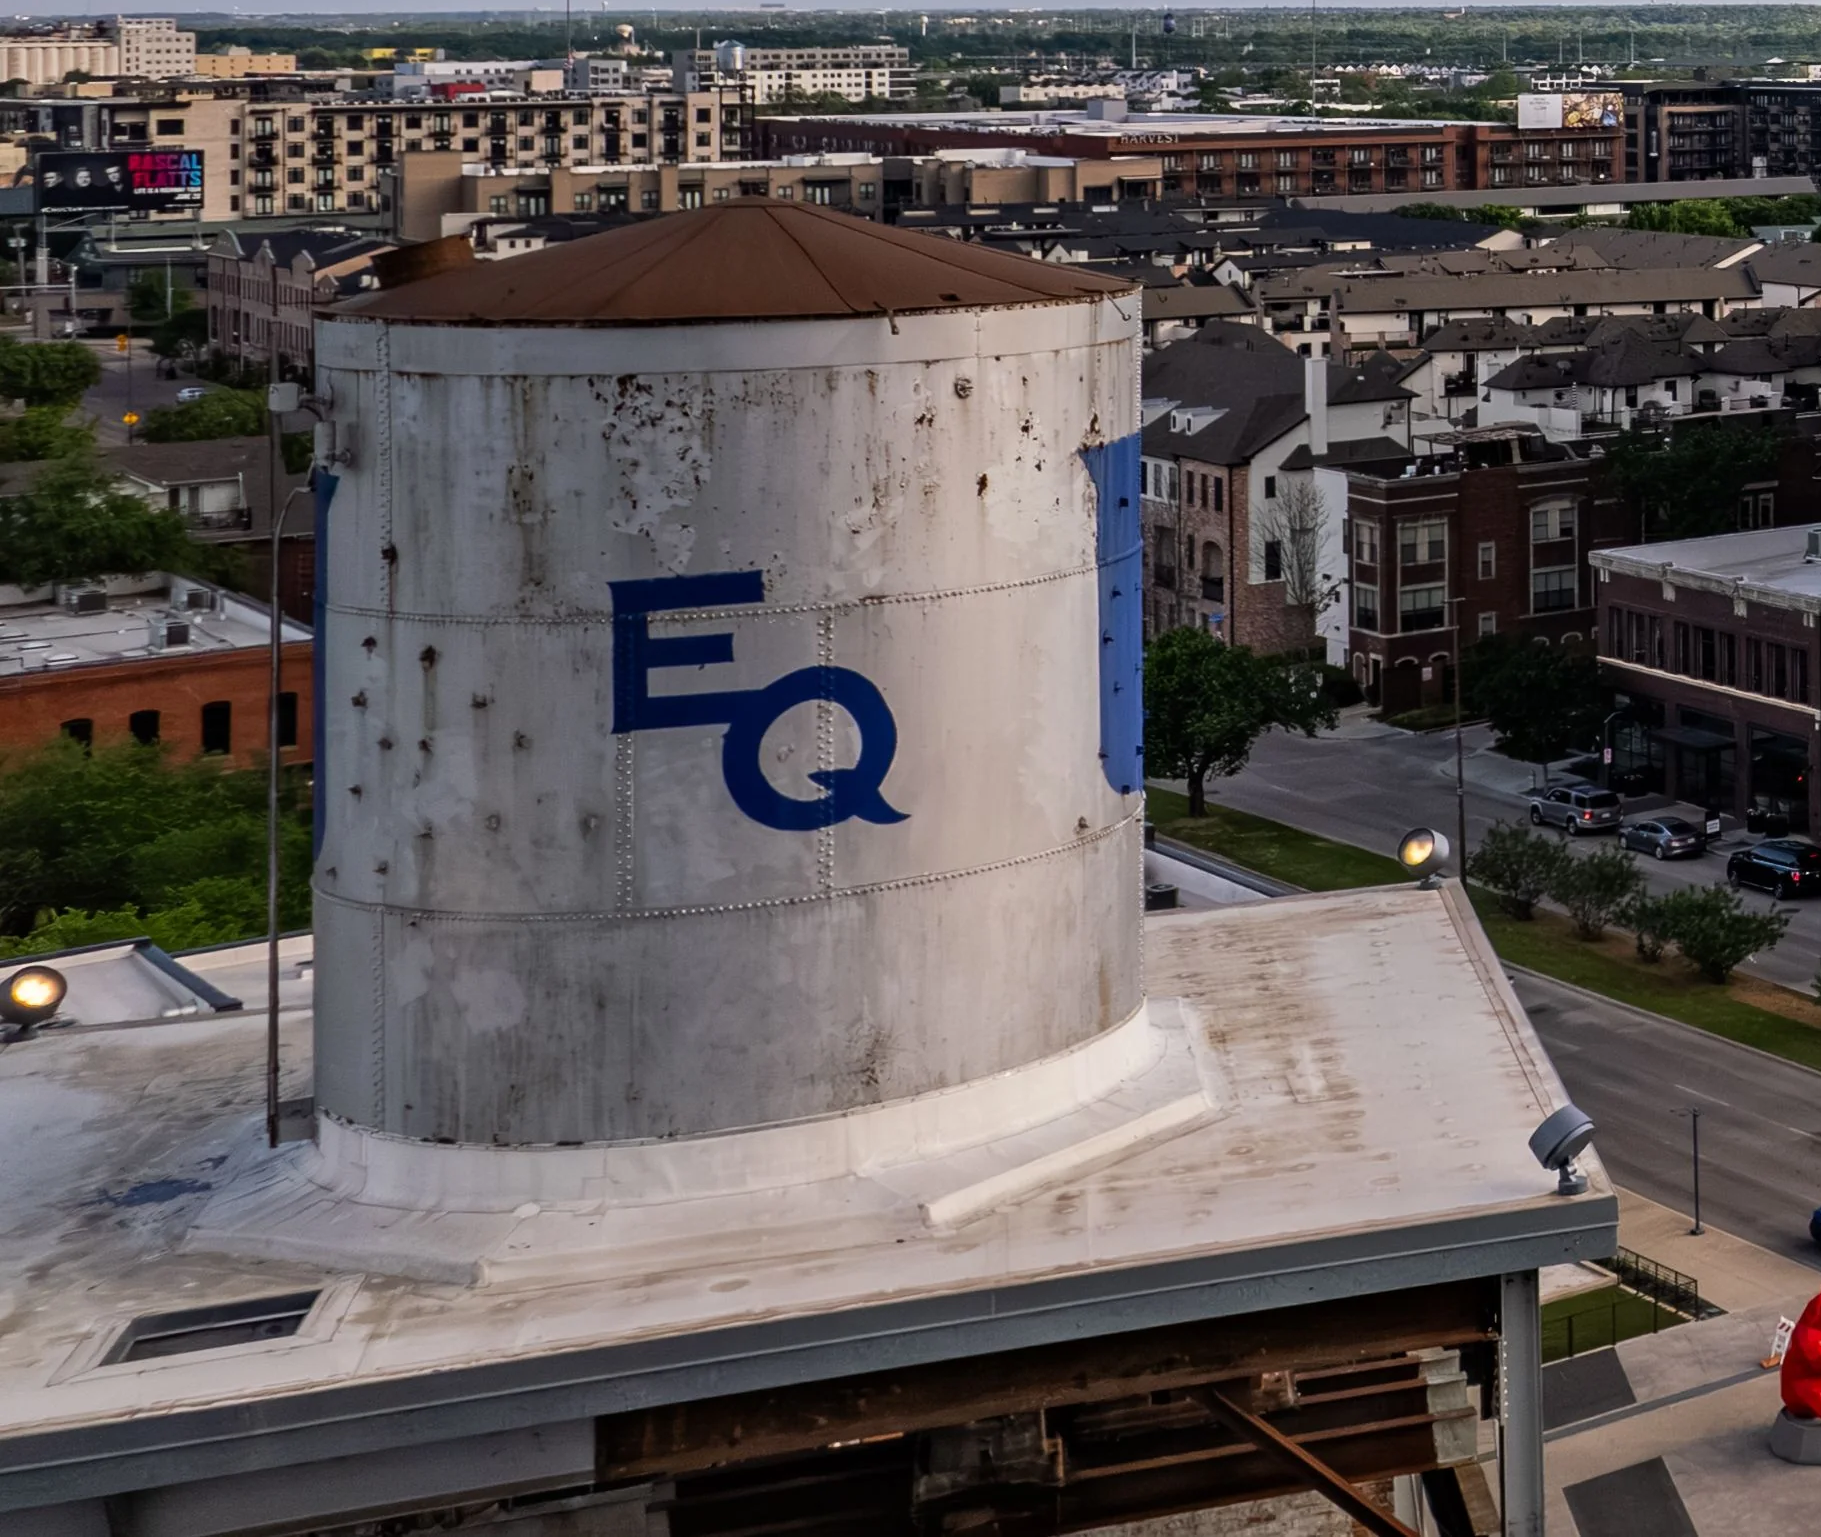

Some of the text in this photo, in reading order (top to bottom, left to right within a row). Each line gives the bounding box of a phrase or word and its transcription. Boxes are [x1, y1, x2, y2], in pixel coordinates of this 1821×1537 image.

[1120, 133, 1179, 144] HARVEST
[128, 153, 202, 170] RASCAL
[133, 170, 201, 186] FLATTS
[606, 569, 911, 831] EQ
